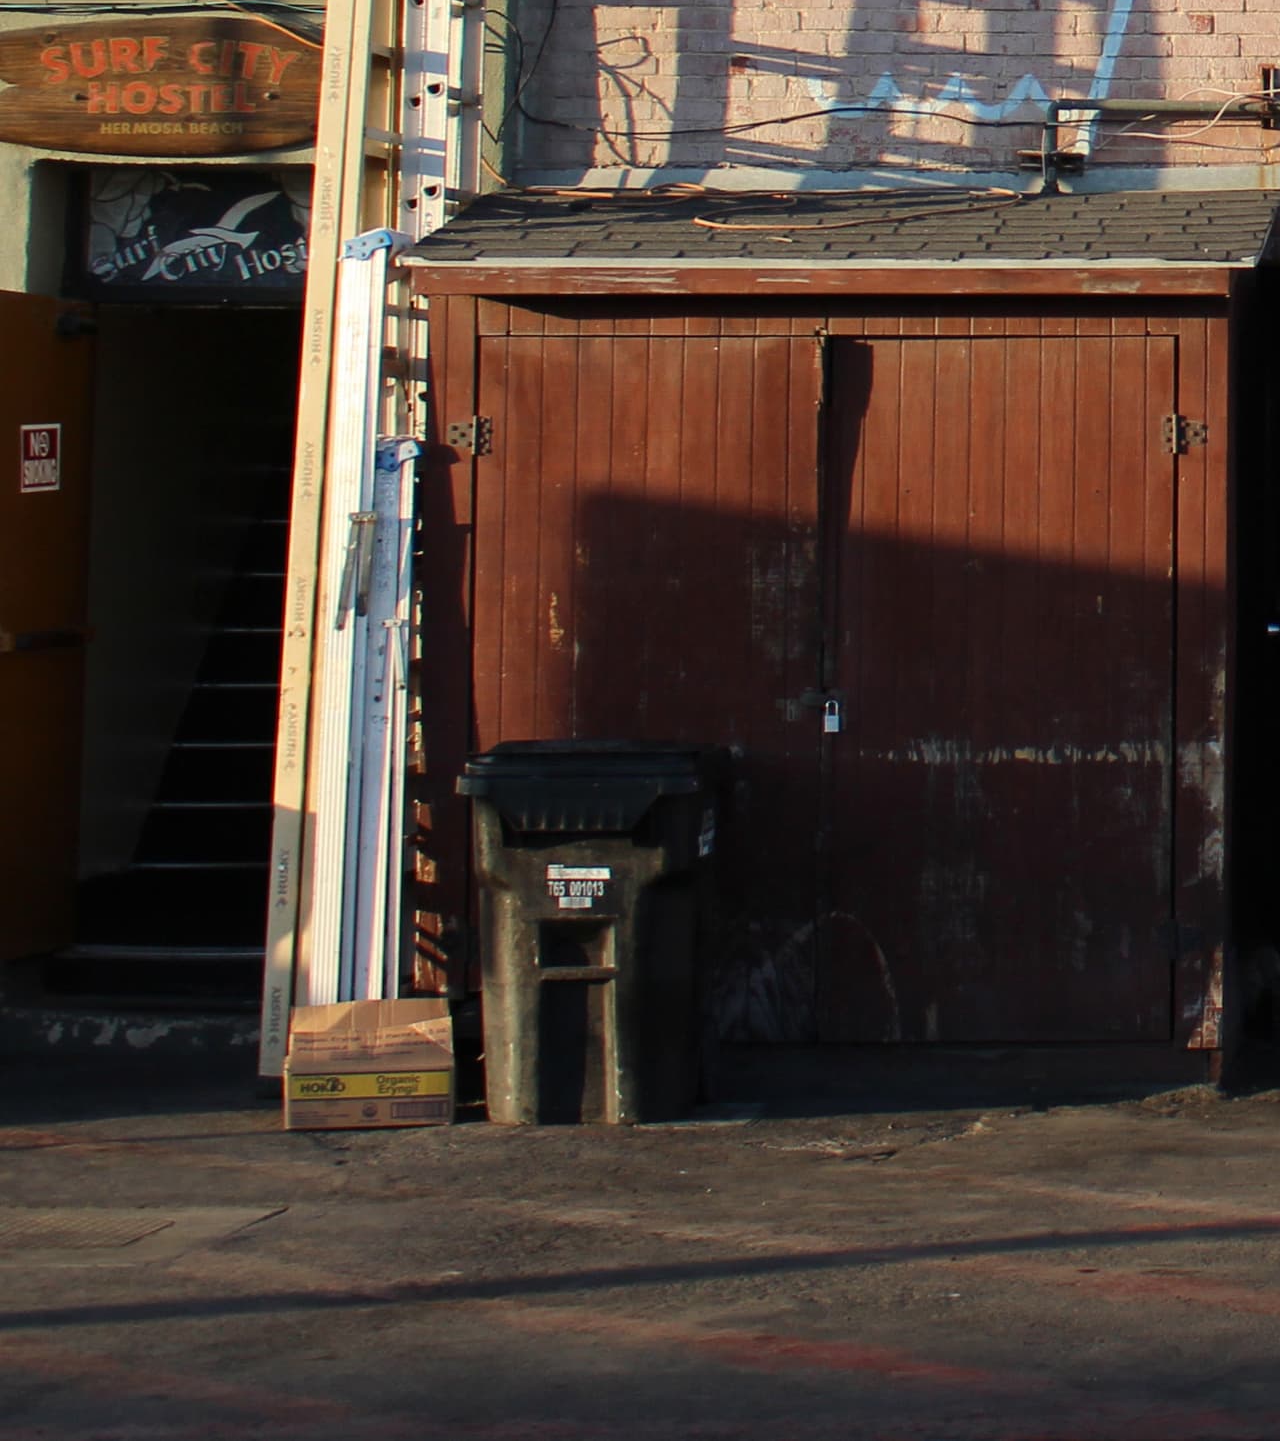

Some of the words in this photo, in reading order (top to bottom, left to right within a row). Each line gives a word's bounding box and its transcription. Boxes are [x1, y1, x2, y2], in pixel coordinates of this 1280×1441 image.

[40, 36, 170, 85] SURF
[188, 41, 300, 86] CITY
[86, 81, 256, 115] HOSTEL
[100, 121, 184, 136] HERMOSA
[190, 122, 243, 135] BEACH
[376, 1075, 421, 1086] Organic
